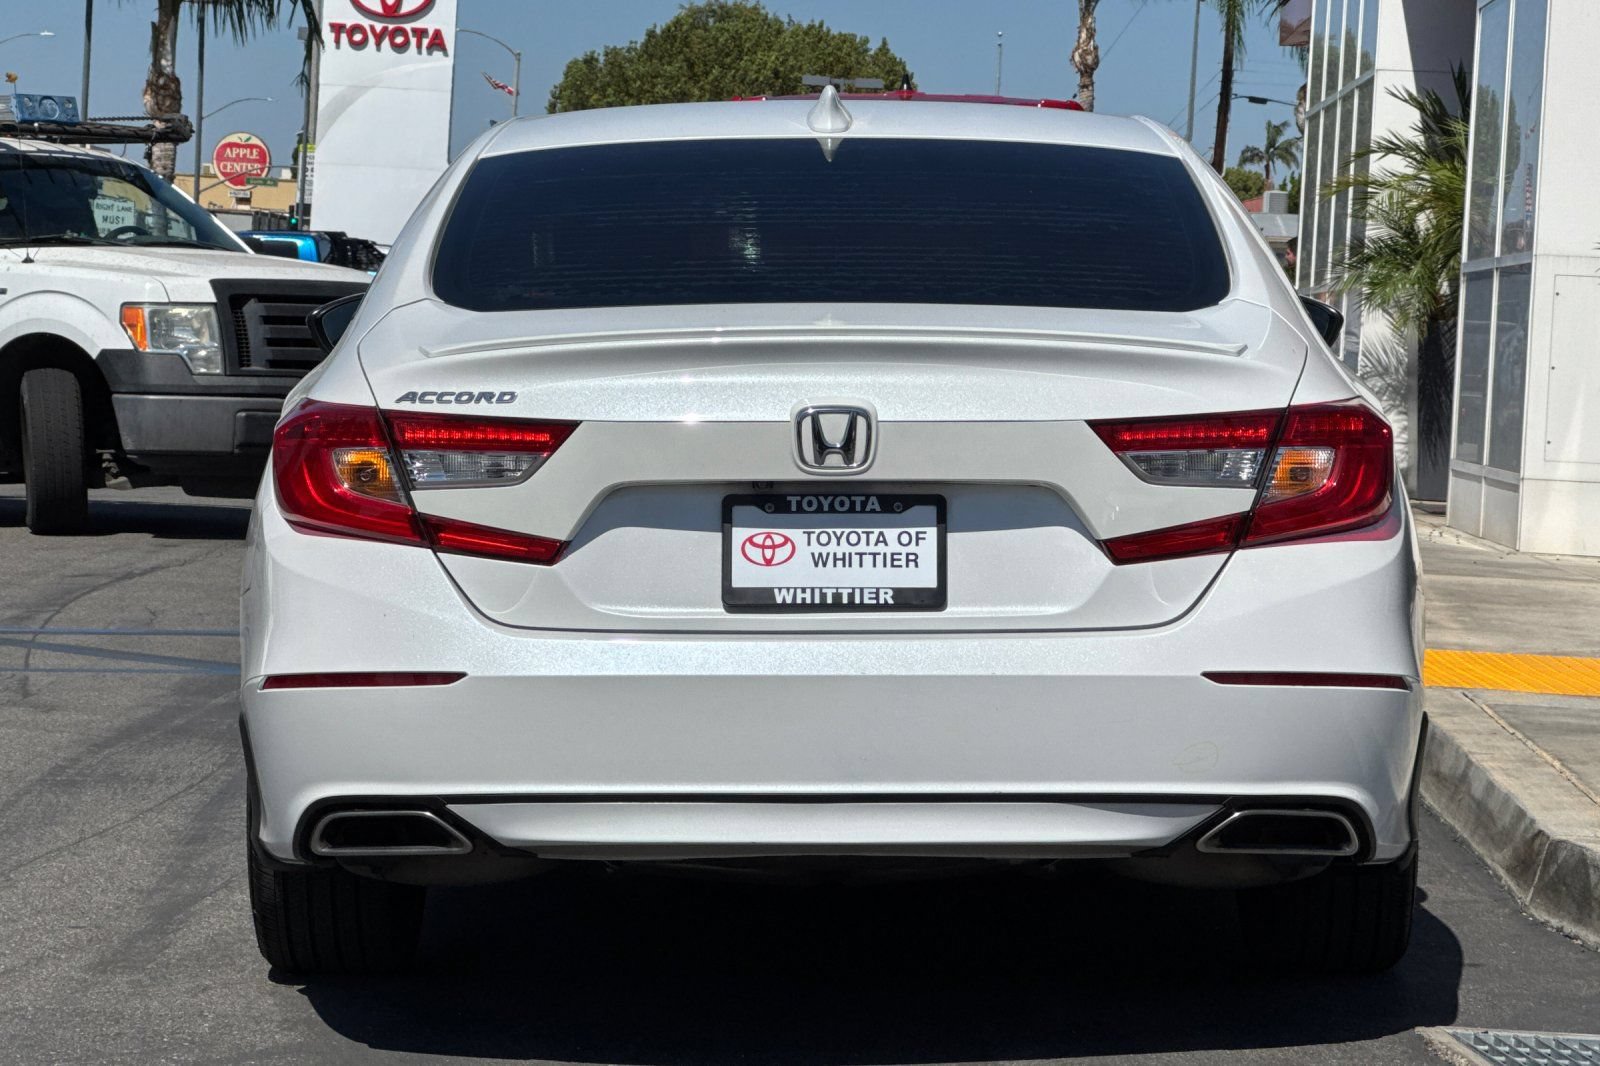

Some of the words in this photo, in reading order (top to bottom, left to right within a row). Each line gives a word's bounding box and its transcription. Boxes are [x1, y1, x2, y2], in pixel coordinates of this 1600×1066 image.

[328, 22, 448, 54] TOYOTA
[224, 147, 260, 159] APPLE
[219, 161, 261, 174] CENTER
[95, 202, 114, 213] RIGHT
[117, 204, 133, 213] LANE
[394, 391, 518, 404] ACCORD
[786, 495, 882, 512] TOYOTA
[803, 530, 889, 547] TOYOTA
[897, 530, 928, 547] OF
[811, 552, 919, 568] WHITTIER
[774, 588, 894, 604] WHITTIER
